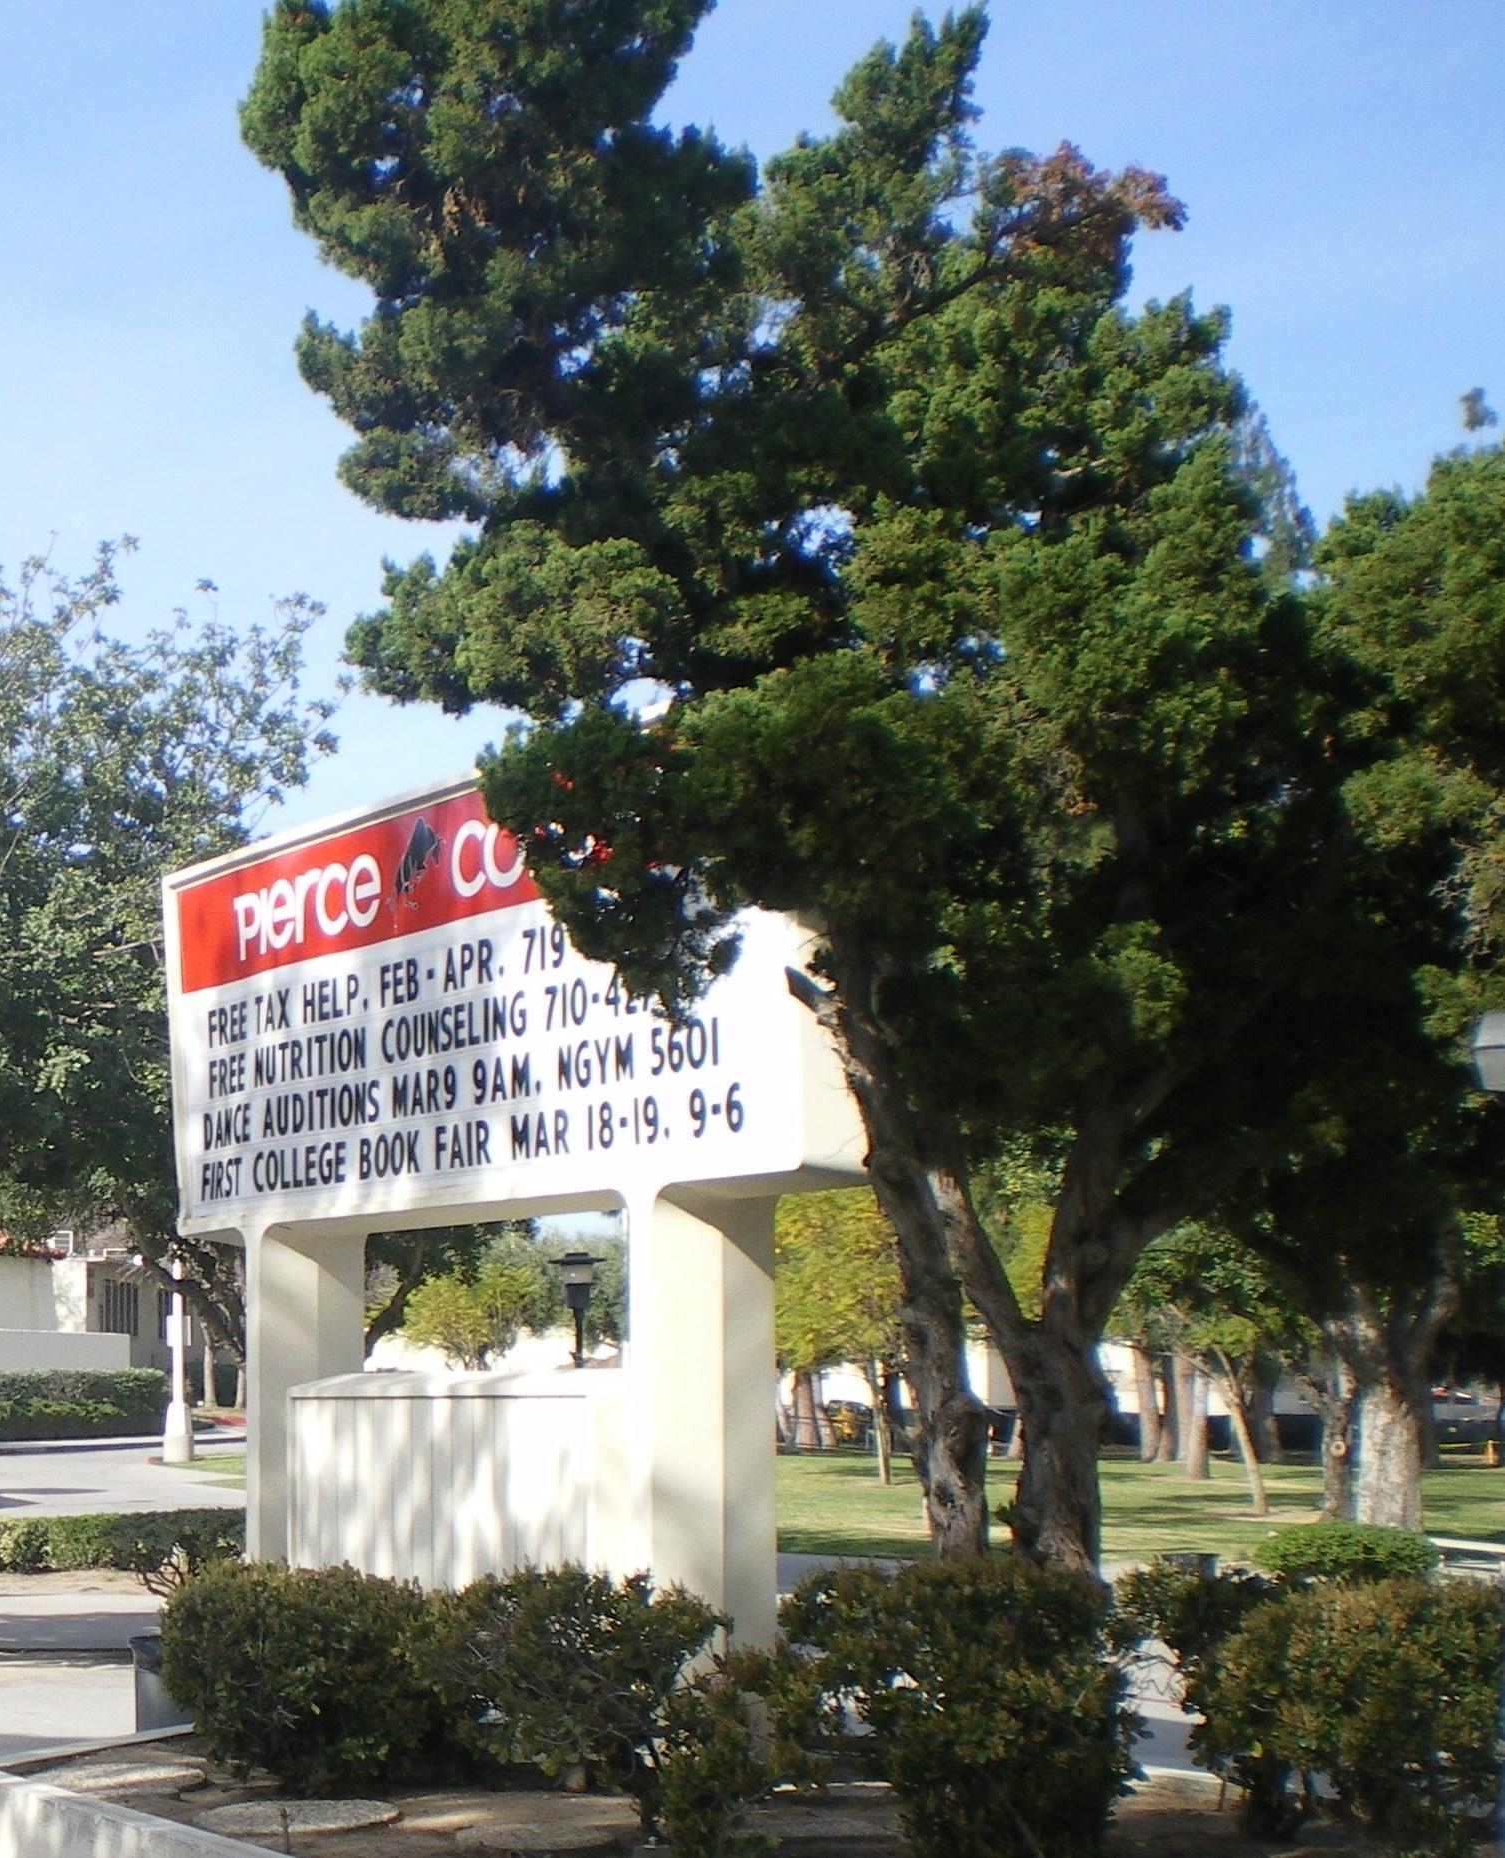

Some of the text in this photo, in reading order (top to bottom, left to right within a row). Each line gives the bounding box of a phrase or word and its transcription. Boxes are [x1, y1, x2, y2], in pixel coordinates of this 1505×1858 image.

[208, 1001, 247, 1048] FREE
[255, 988, 290, 1035] TAX
[209, 1052, 246, 1099] FREE
[254, 1027, 366, 1088] NUTRITION
[381, 990, 528, 1063] COUNSELING
[203, 1103, 251, 1151] DANCE
[262, 1080, 380, 1138] AUDITIONS
[558, 1033, 634, 1091] NGYM
[651, 1017, 719, 1076] 5601
[202, 1157, 242, 1201] FIRST
[253, 1141, 346, 1193] COLLEGE
[359, 1129, 420, 1180] BOOK
[435, 1120, 491, 1170] FAIR
[511, 1109, 570, 1161] MAR
[689, 1082, 744, 1138] 9-6
